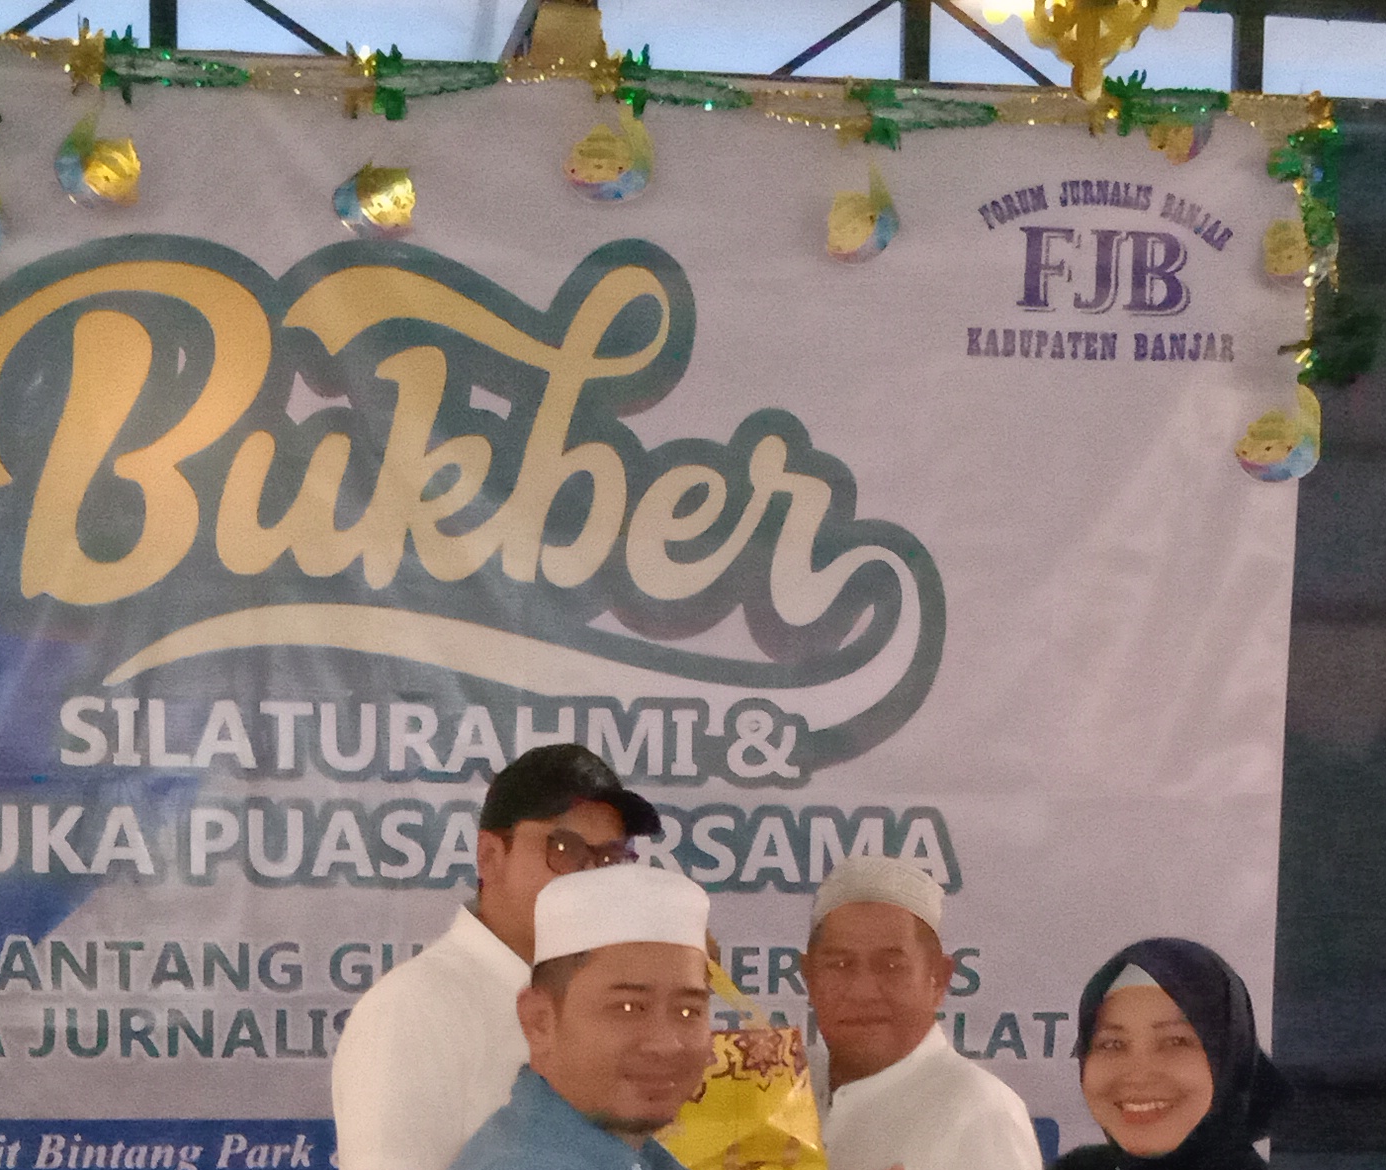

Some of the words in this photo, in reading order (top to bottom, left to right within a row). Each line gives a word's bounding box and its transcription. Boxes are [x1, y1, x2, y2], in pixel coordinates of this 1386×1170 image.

[979, 184, 1050, 230] FORUM
[1059, 180, 1153, 211] JURNALIS
[1016, 226, 1191, 316] FJB
[966, 327, 1118, 359] KABUPATEN
[1133, 332, 1234, 361] BANJAR
[60, 695, 699, 778] SILATURAHMI
[726, 708, 801, 779] &
[190, 806, 479, 879] PUASA
[215, 1133, 314, 1170] Park
